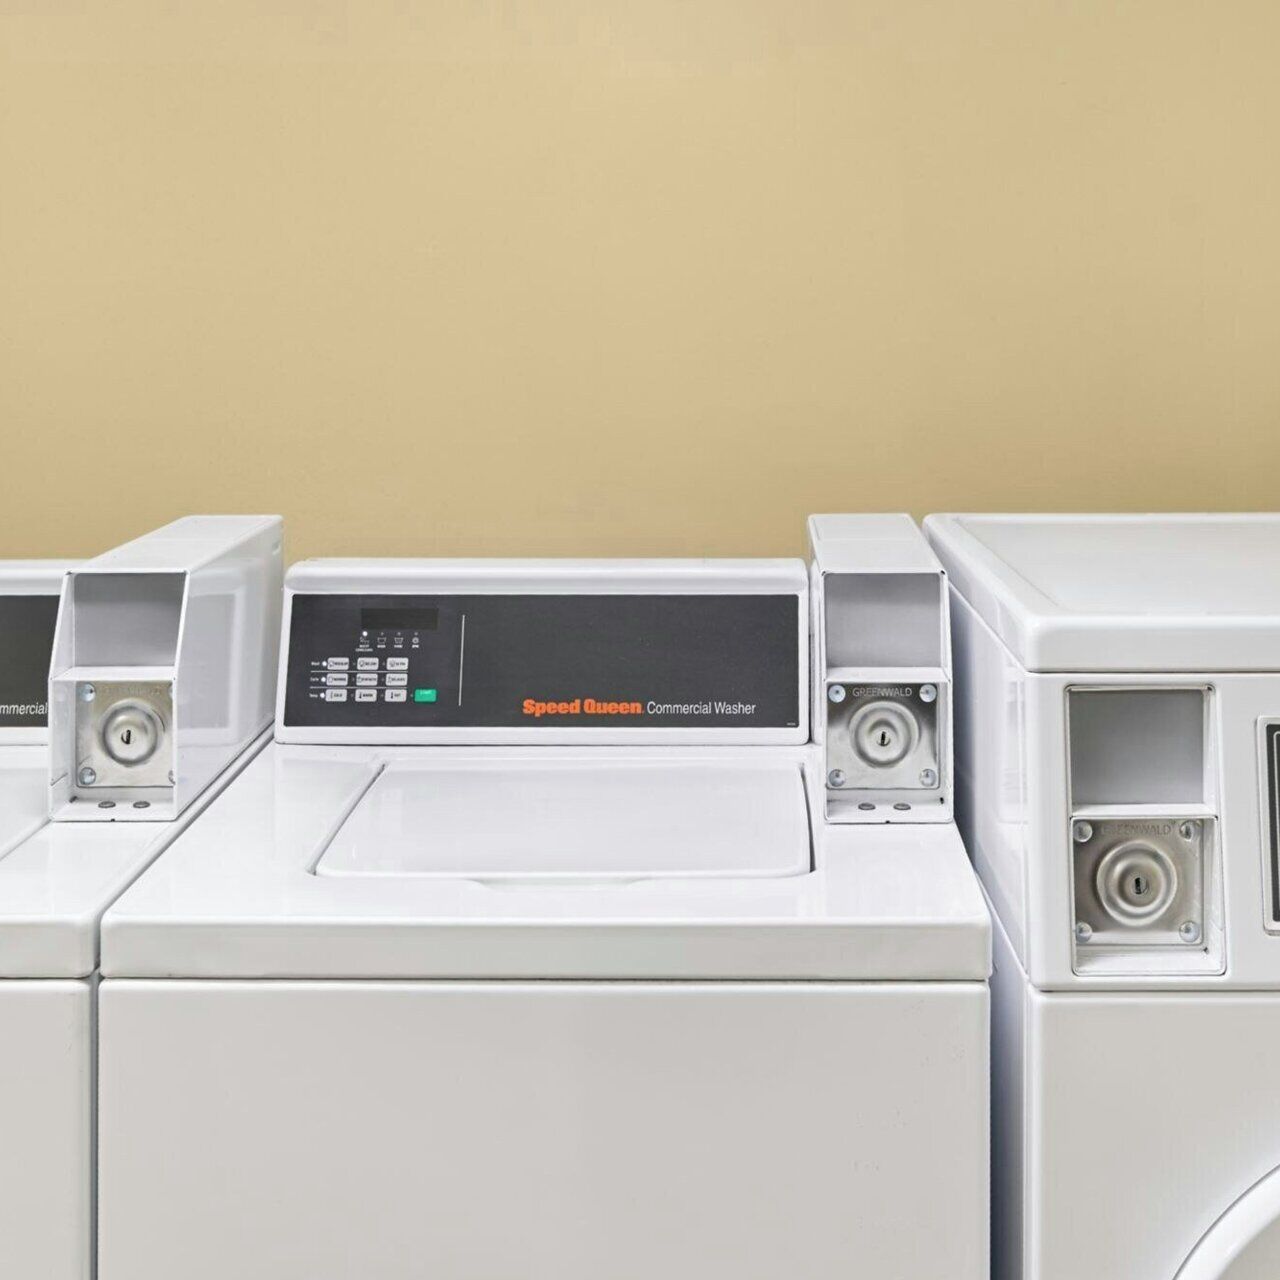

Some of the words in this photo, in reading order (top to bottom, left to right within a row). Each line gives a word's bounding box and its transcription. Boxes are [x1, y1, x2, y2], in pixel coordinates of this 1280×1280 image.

[852, 687, 913, 697] GREENWALD
[522, 699, 581, 717] Speed
[583, 698, 642, 714] Queen
[646, 701, 712, 715] Commercial
[714, 702, 756, 715] Washer
